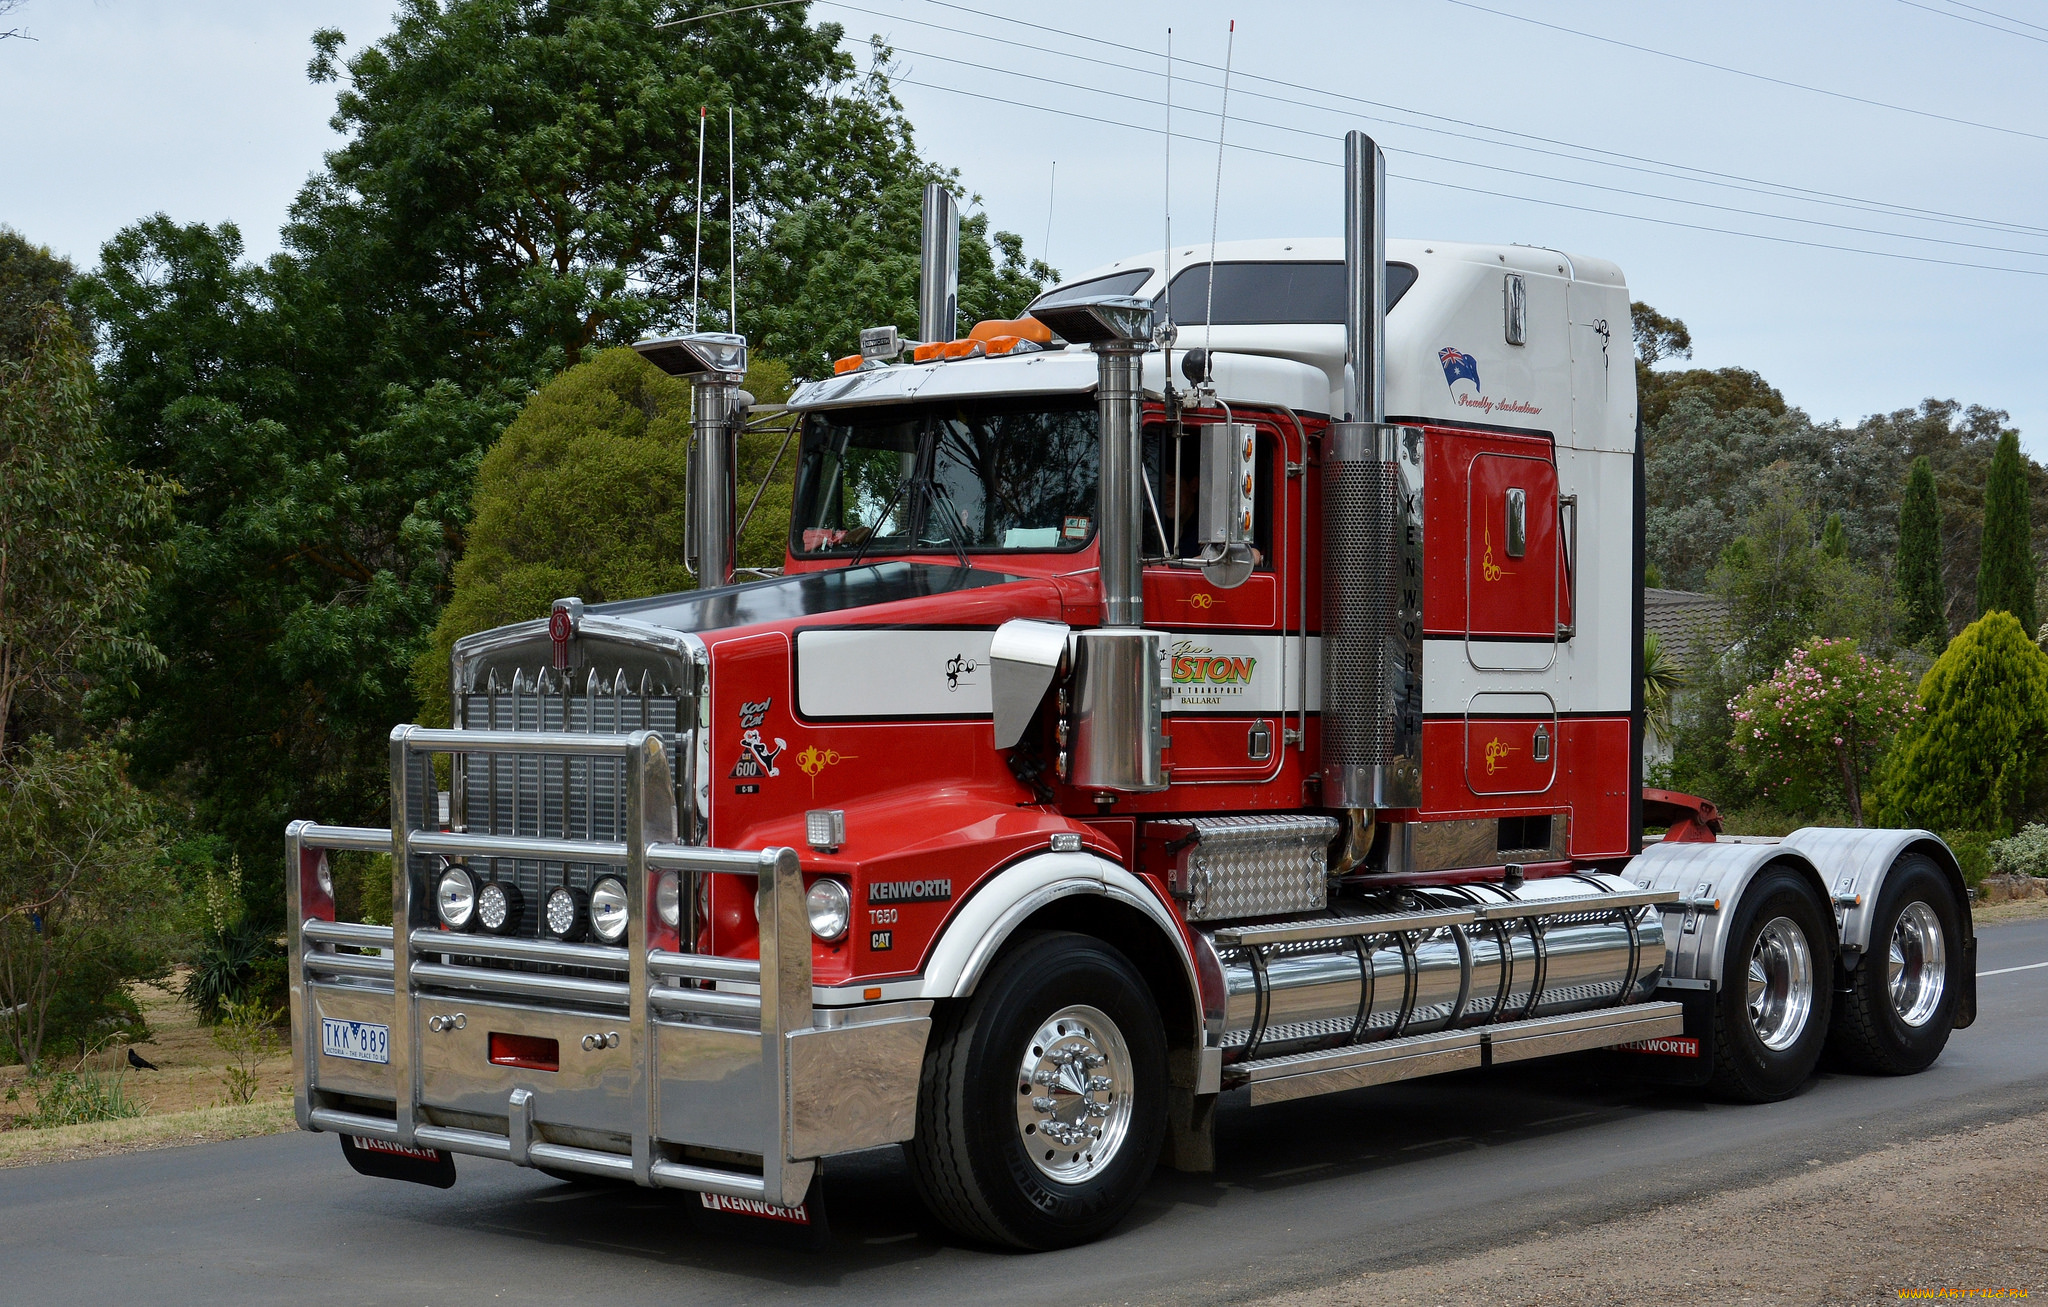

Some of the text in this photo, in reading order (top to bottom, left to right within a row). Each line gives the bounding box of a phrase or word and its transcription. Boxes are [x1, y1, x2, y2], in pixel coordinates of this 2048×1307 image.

[1458, 393, 1542, 415] Proudly Australian
[1403, 493, 1417, 736] KENWORTH
[739, 697, 772, 717] Kool
[740, 713, 764, 729] Cat
[736, 762, 756, 776] 600
[869, 879, 952, 901] KENWORTH
[868, 908, 898, 925] T650
[872, 932, 890, 949] CAT
[325, 1023, 386, 1053] TKK 889
[326, 1047, 345, 1055] VICTORIA
[358, 1052, 371, 1060] PLACE
